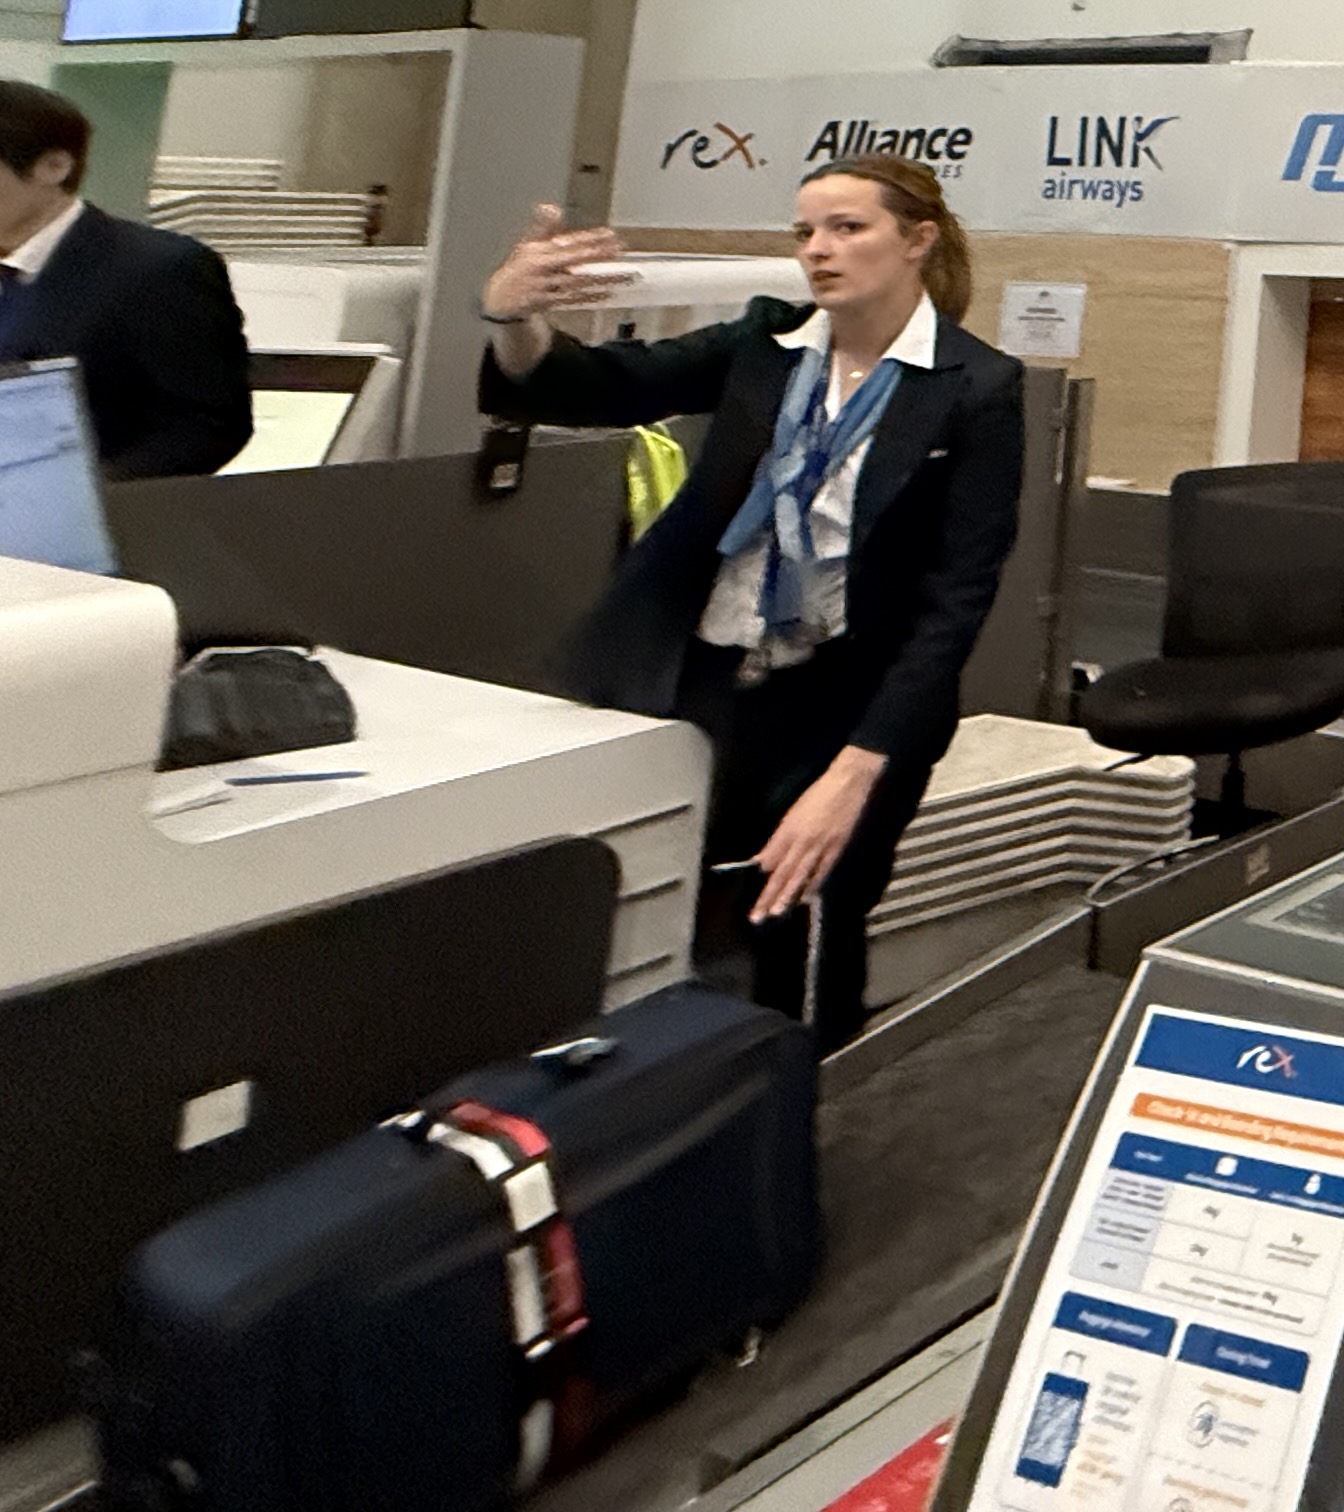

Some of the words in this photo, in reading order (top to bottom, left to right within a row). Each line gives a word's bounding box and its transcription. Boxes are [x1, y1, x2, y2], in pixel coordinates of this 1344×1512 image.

[806, 120, 973, 164] Alliance
[1046, 116, 1181, 171] LINK
[1041, 174, 1145, 209] airways
